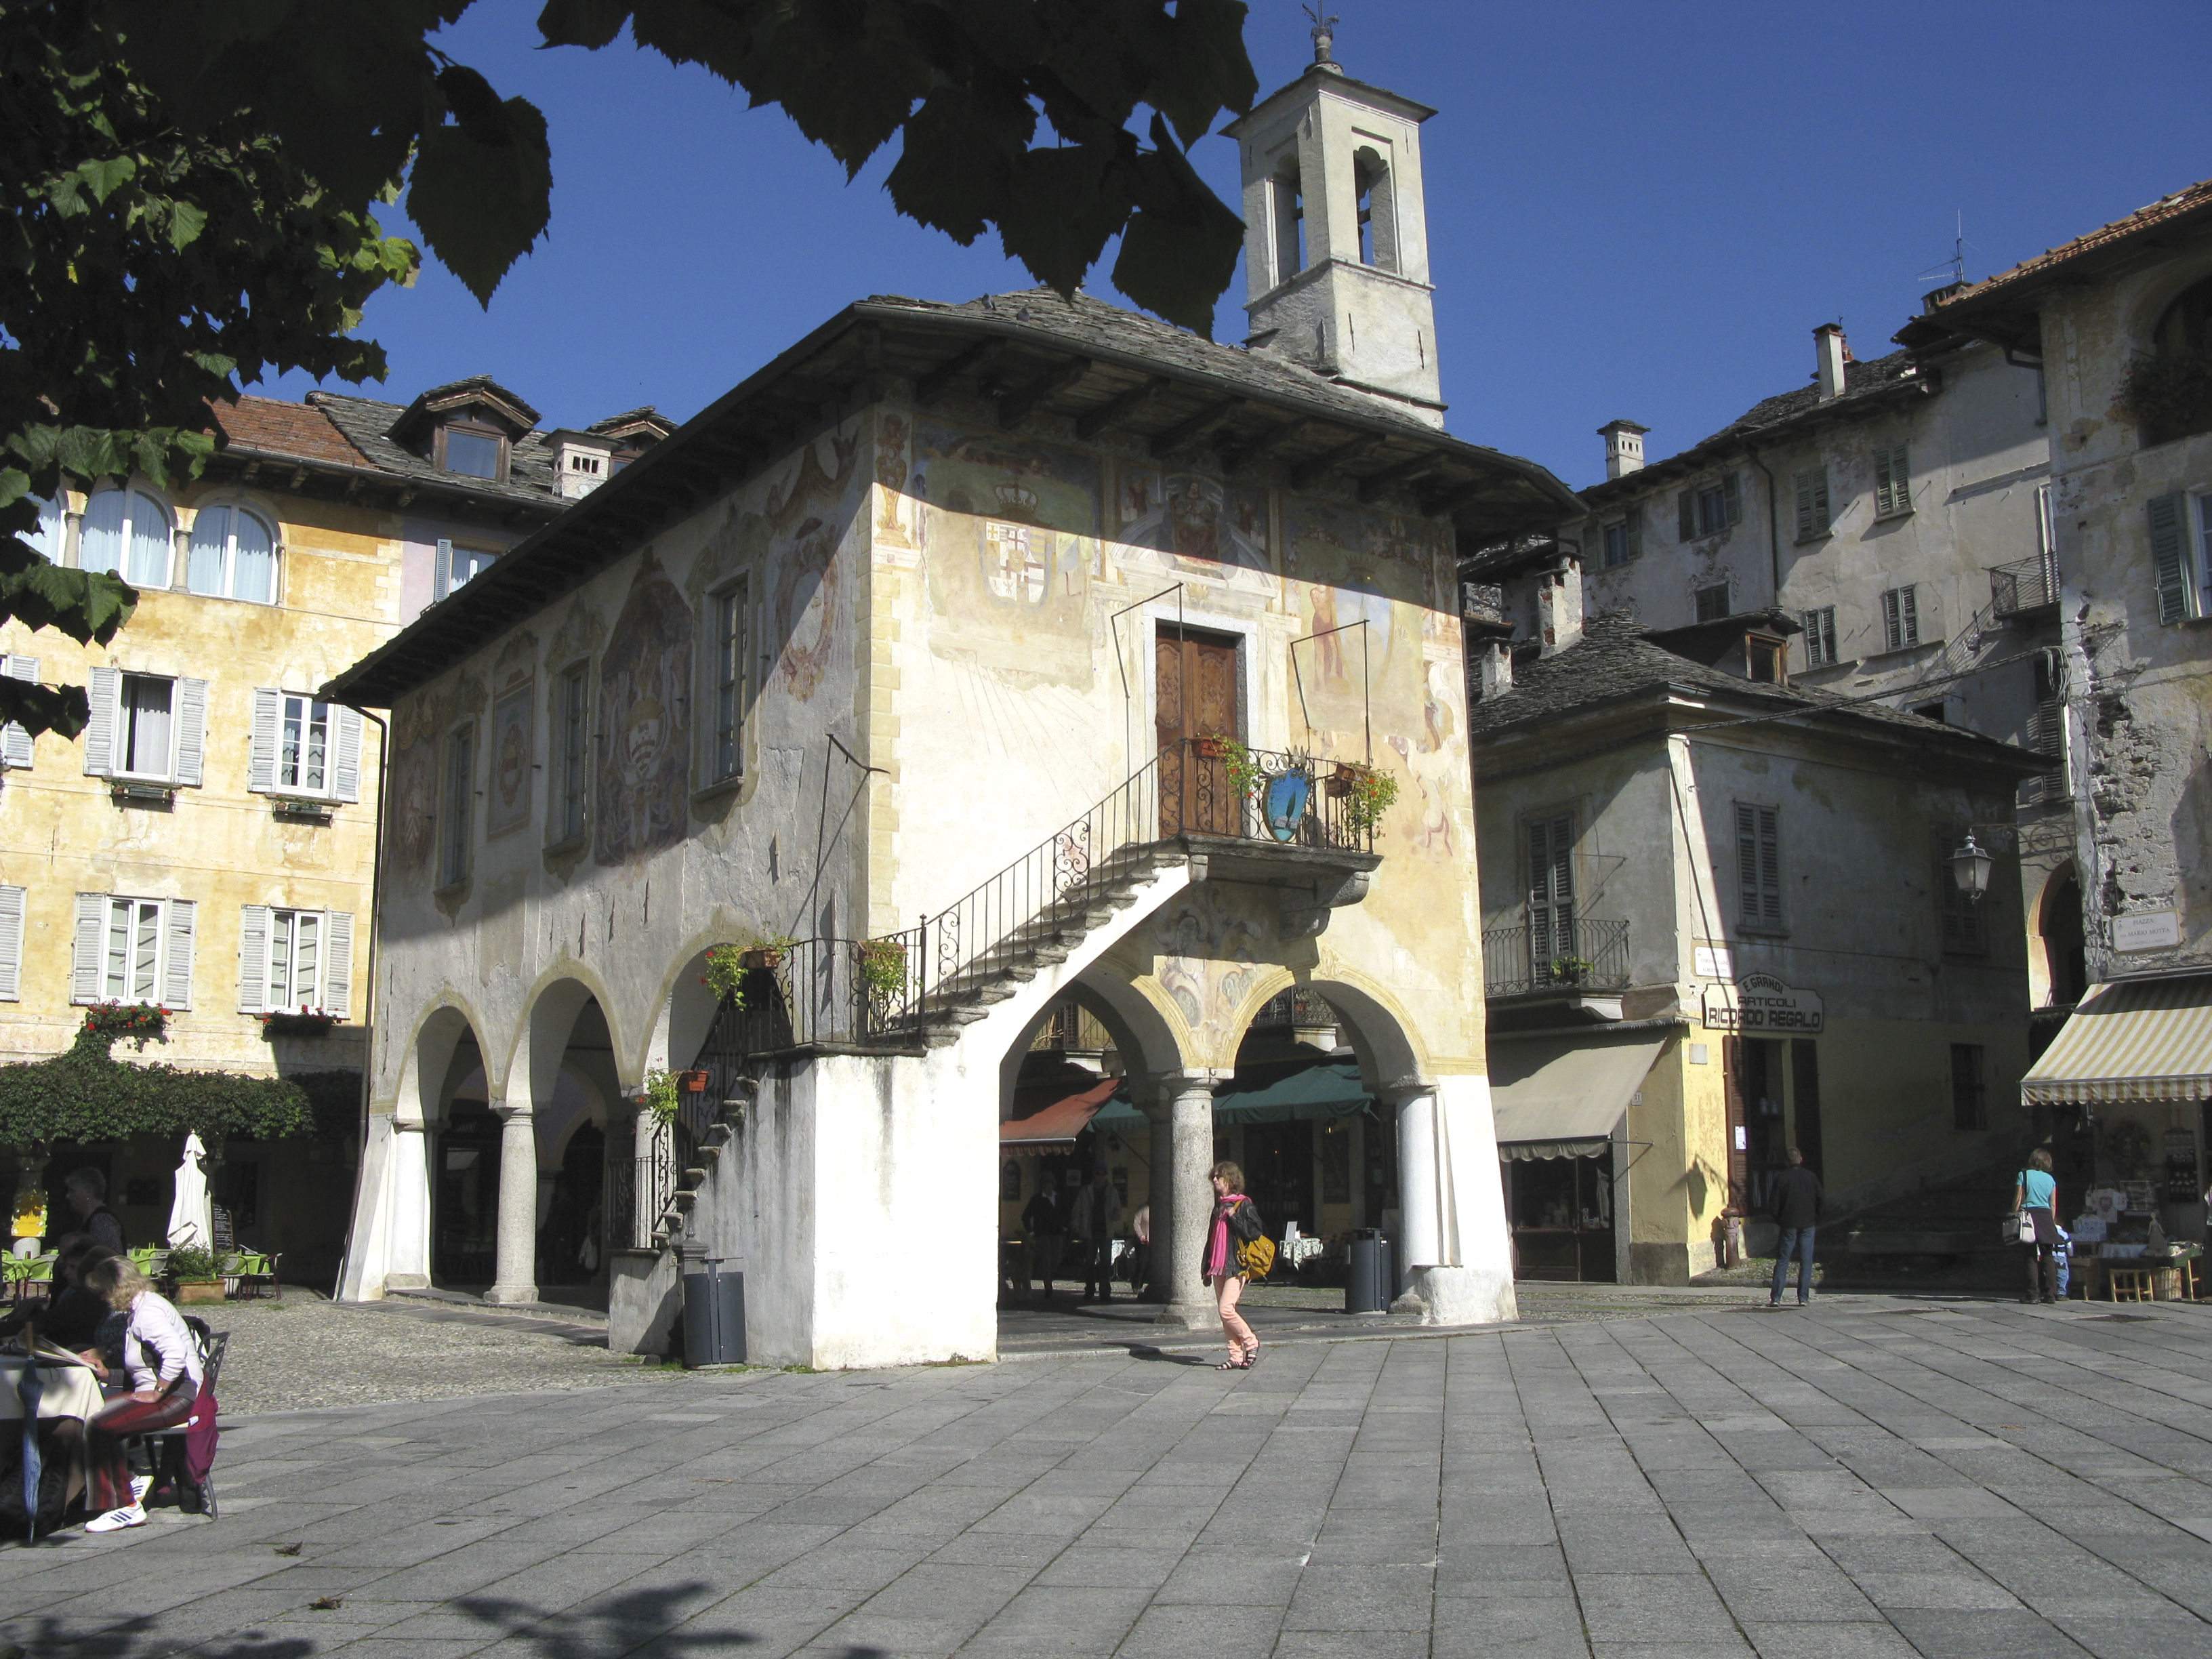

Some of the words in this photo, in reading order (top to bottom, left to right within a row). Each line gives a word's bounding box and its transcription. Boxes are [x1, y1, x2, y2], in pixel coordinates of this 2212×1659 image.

[1737, 996, 1796, 1008] ARTICOLI
[1708, 1007, 1763, 1026] RICORDO
[1768, 1010, 1820, 1028] REGALO
